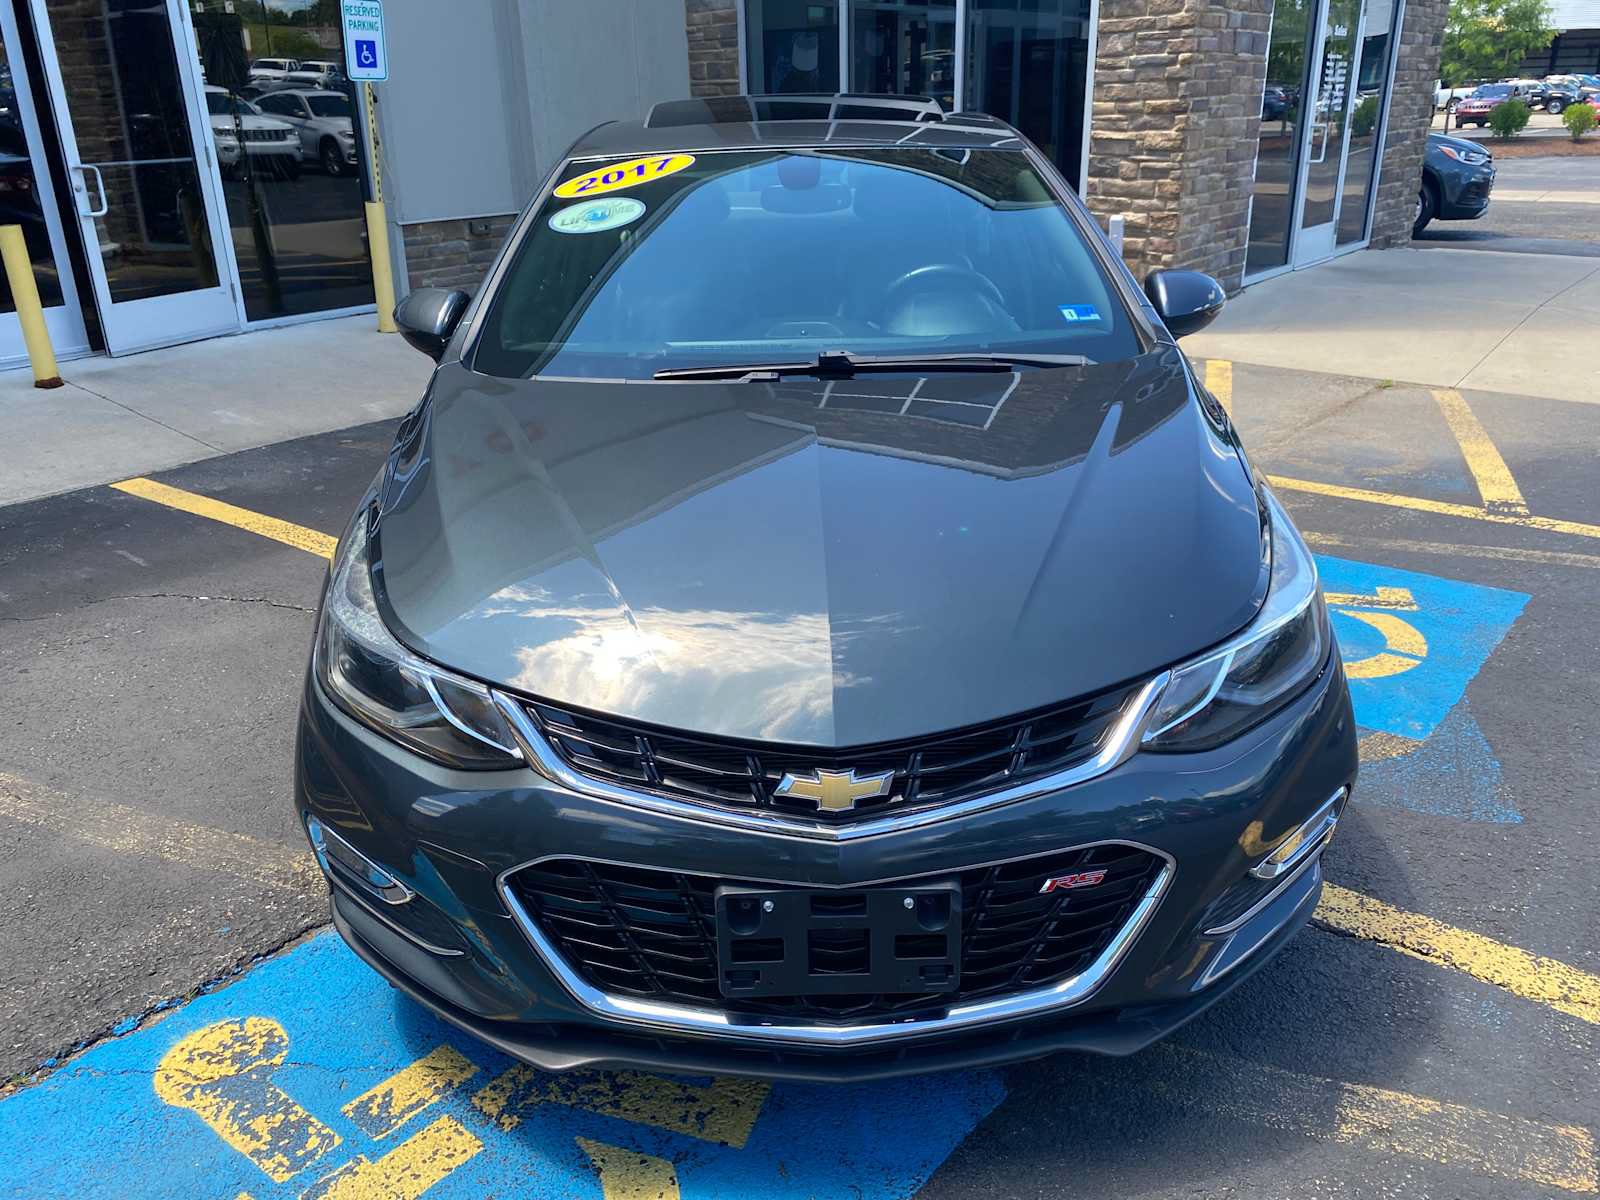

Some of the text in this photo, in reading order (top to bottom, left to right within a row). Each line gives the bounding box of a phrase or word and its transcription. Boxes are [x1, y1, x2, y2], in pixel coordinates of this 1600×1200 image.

[345, 5, 379, 17] RESERVED
[348, 20, 379, 31] PARKING
[575, 157, 673, 193] 2017
[1039, 869, 1108, 893] RS
